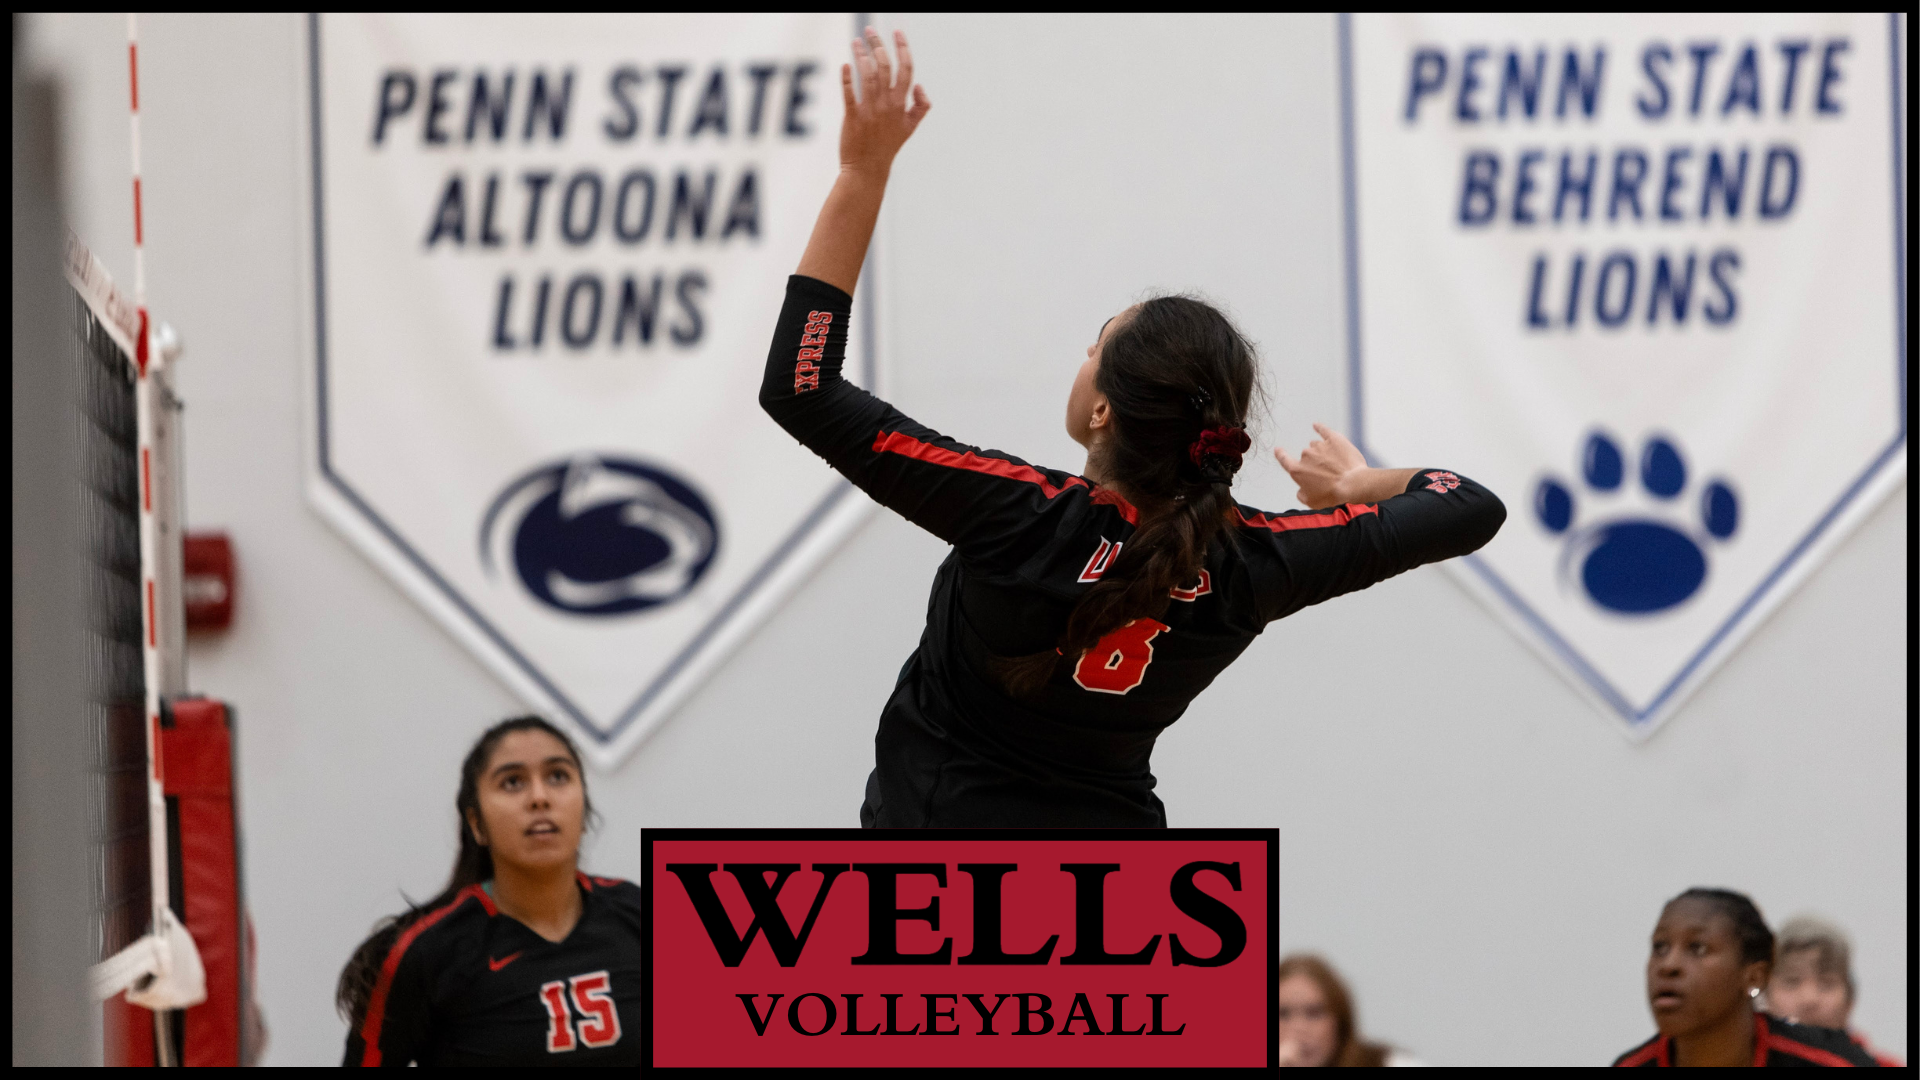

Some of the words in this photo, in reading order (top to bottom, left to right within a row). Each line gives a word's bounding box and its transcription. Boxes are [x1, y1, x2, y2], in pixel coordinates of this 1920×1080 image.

[370, 67, 576, 148] PENN
[602, 61, 819, 143] STATE
[1403, 46, 1606, 125] PENN
[1635, 38, 1850, 121] STATE
[424, 166, 763, 250] ALTOONA
[1456, 144, 1803, 229] BEHREND
[490, 271, 710, 353] LIONS
[1524, 247, 1743, 332] LIONS
[540, 970, 622, 1053] 15
